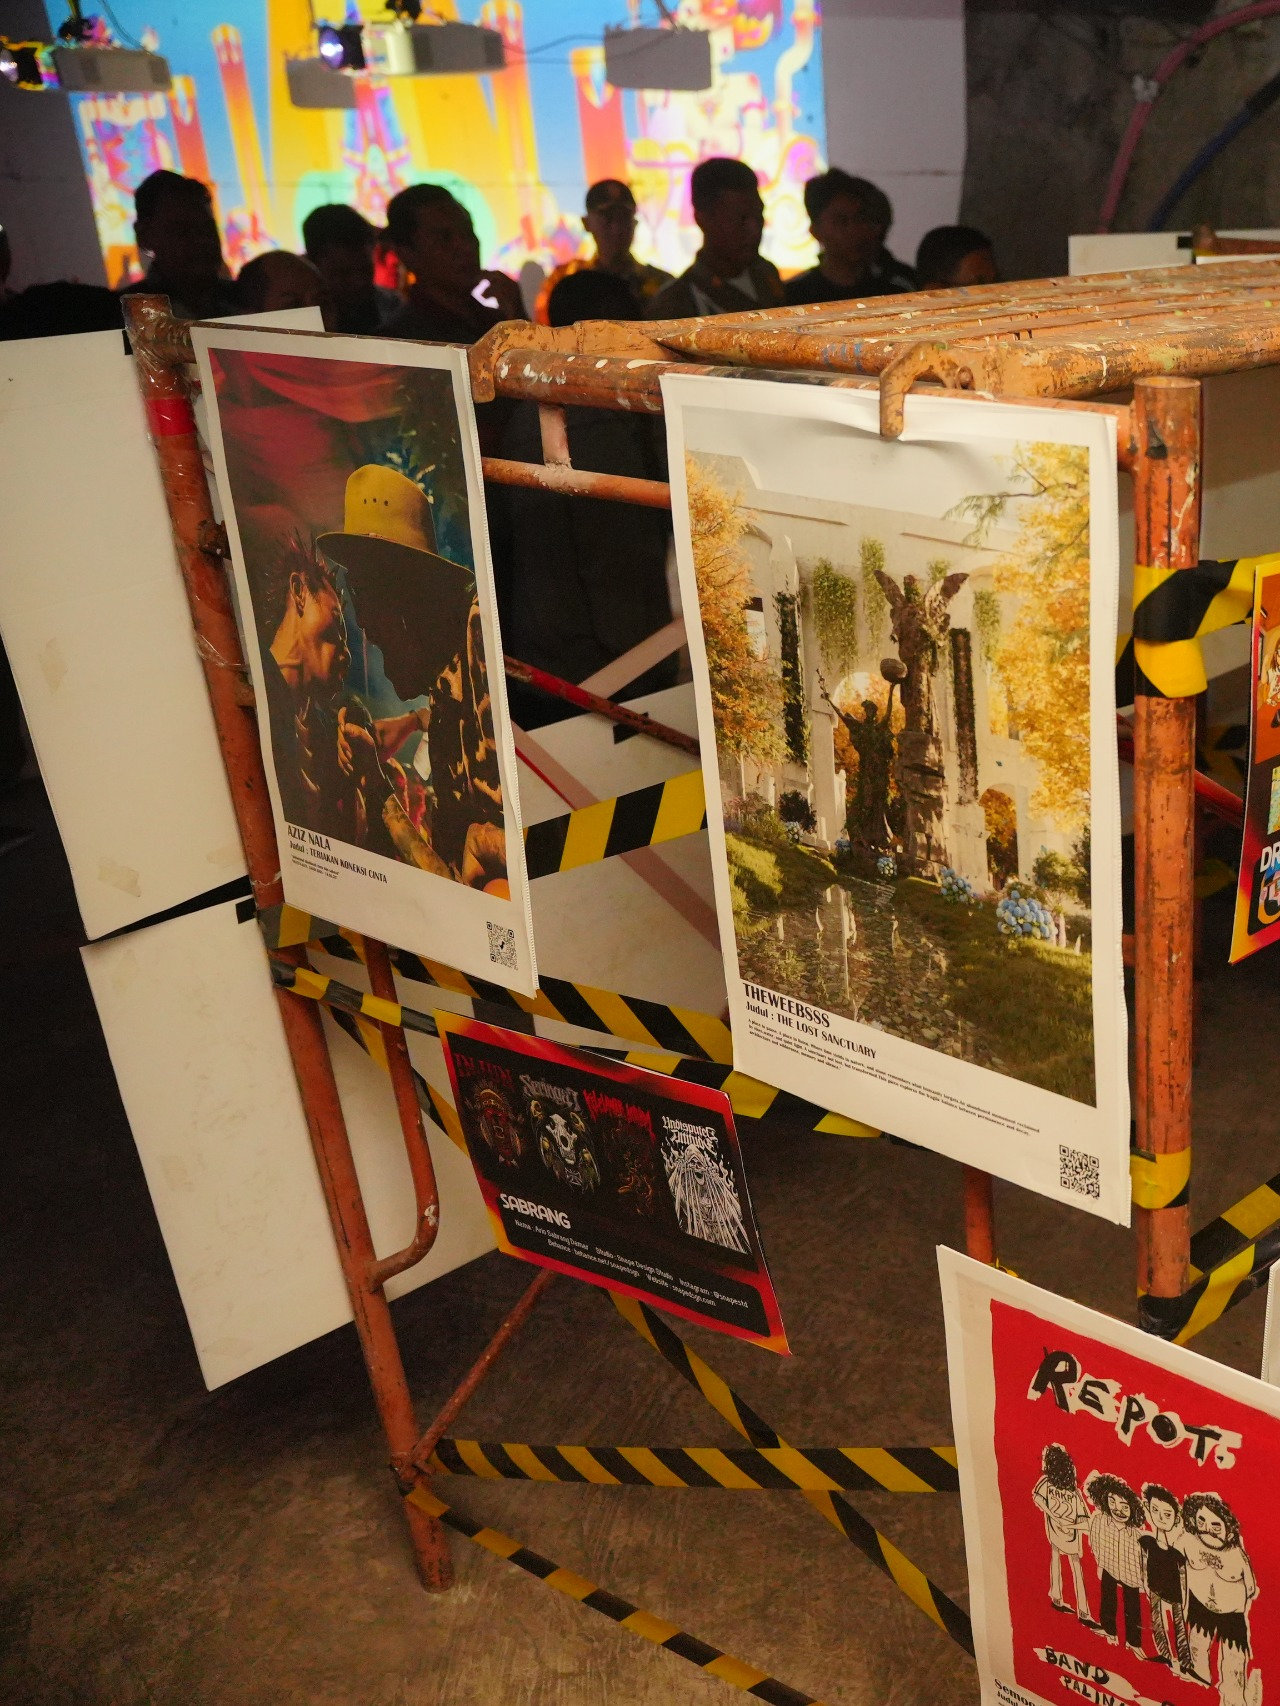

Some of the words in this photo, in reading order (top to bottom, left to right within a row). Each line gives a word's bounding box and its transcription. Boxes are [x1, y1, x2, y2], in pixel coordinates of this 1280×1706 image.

[287, 824, 307, 843] AZIZ
[308, 831, 332, 851] NALA
[339, 859, 367, 876] KONEKSI
[368, 869, 388, 884] CINTA
[742, 982, 831, 1029] THEWEEBSSS
[745, 1001, 769, 1019] Judul
[776, 1012, 795, 1029] THE
[796, 1020, 819, 1038] LOST
[821, 1030, 877, 1059] SANCTUARY
[499, 1193, 572, 1230] SABRANG
[1049, 1496, 1075, 1523] 22
[1045, 1647, 1110, 1685] BAND
[1063, 1675, 1126, 1706] PALIN
